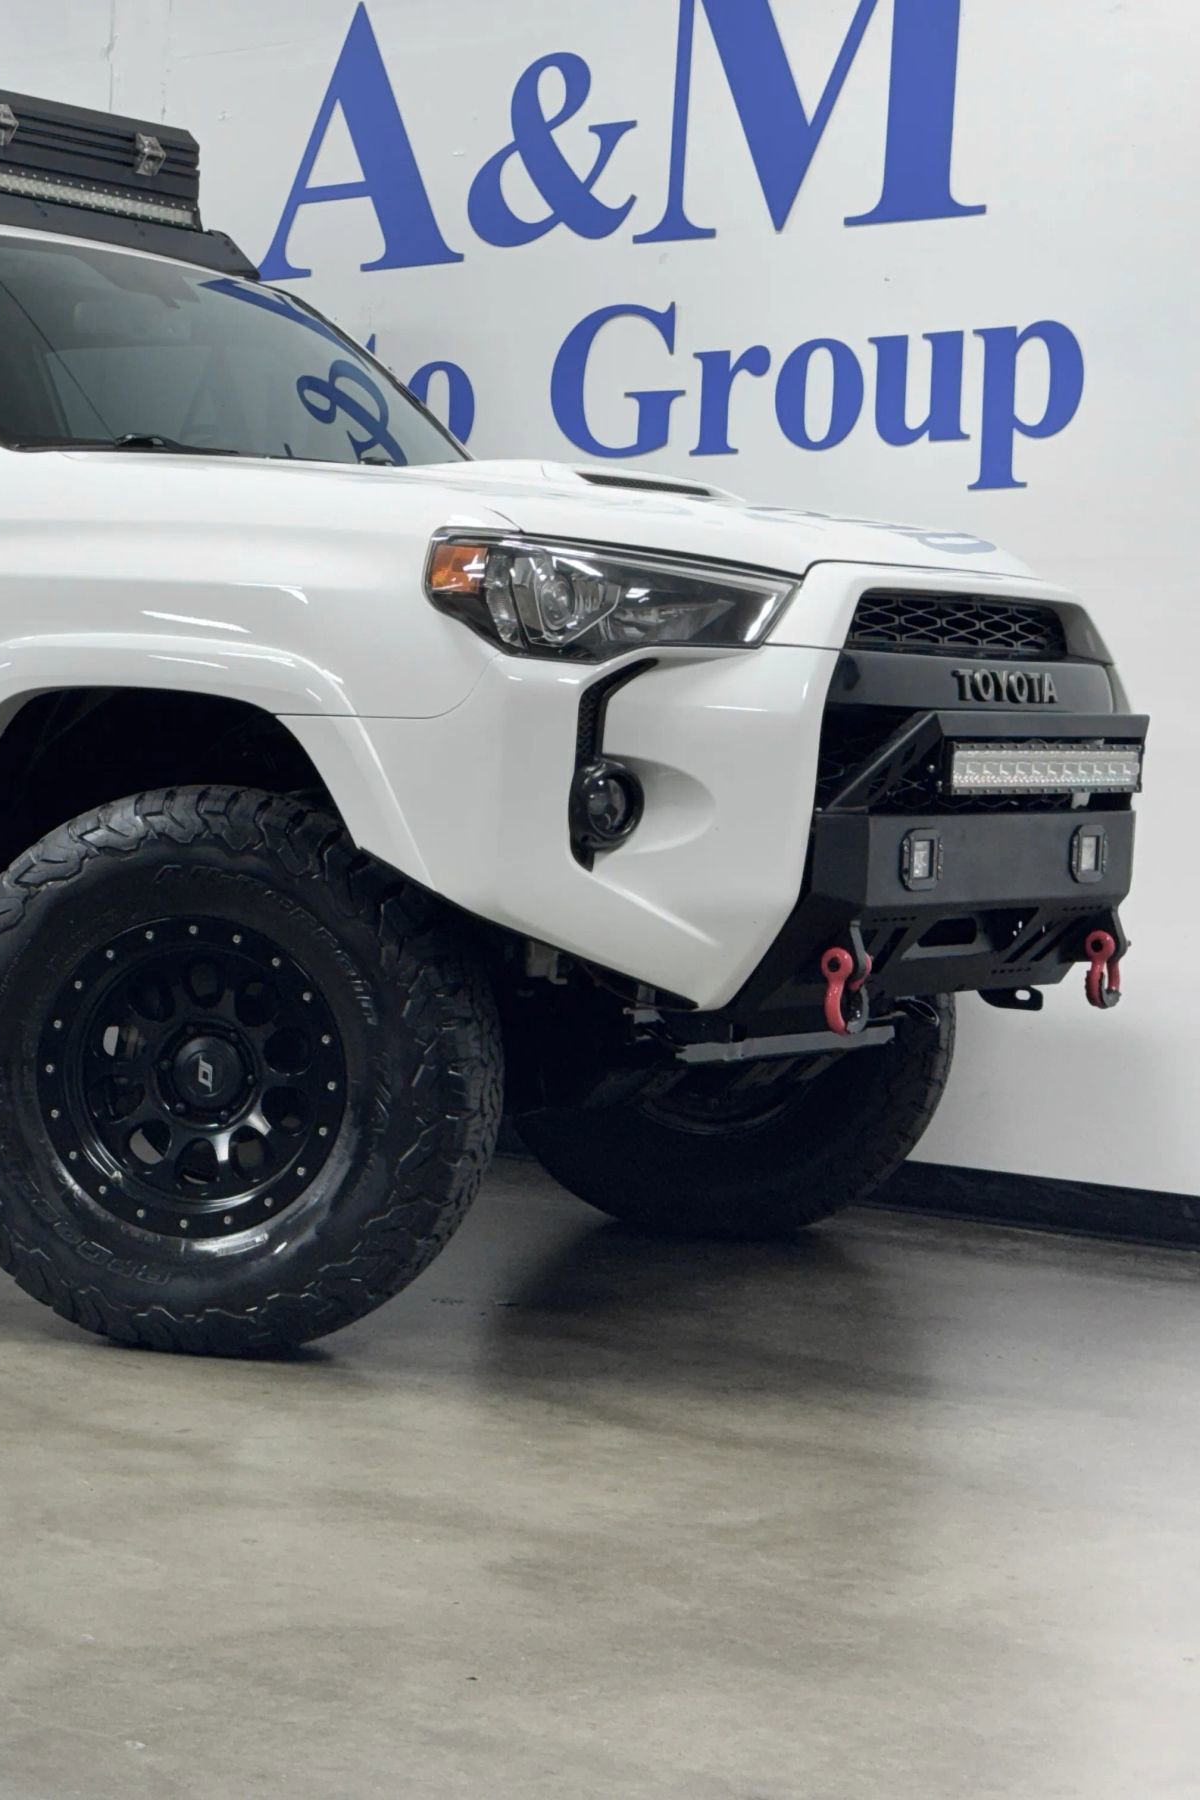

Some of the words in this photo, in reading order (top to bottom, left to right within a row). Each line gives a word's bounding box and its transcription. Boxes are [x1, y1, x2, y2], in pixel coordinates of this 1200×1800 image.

[259, 0, 986, 281] A&M
[550, 301, 1084, 491] Group
[952, 668, 1058, 703] TOYOTA
